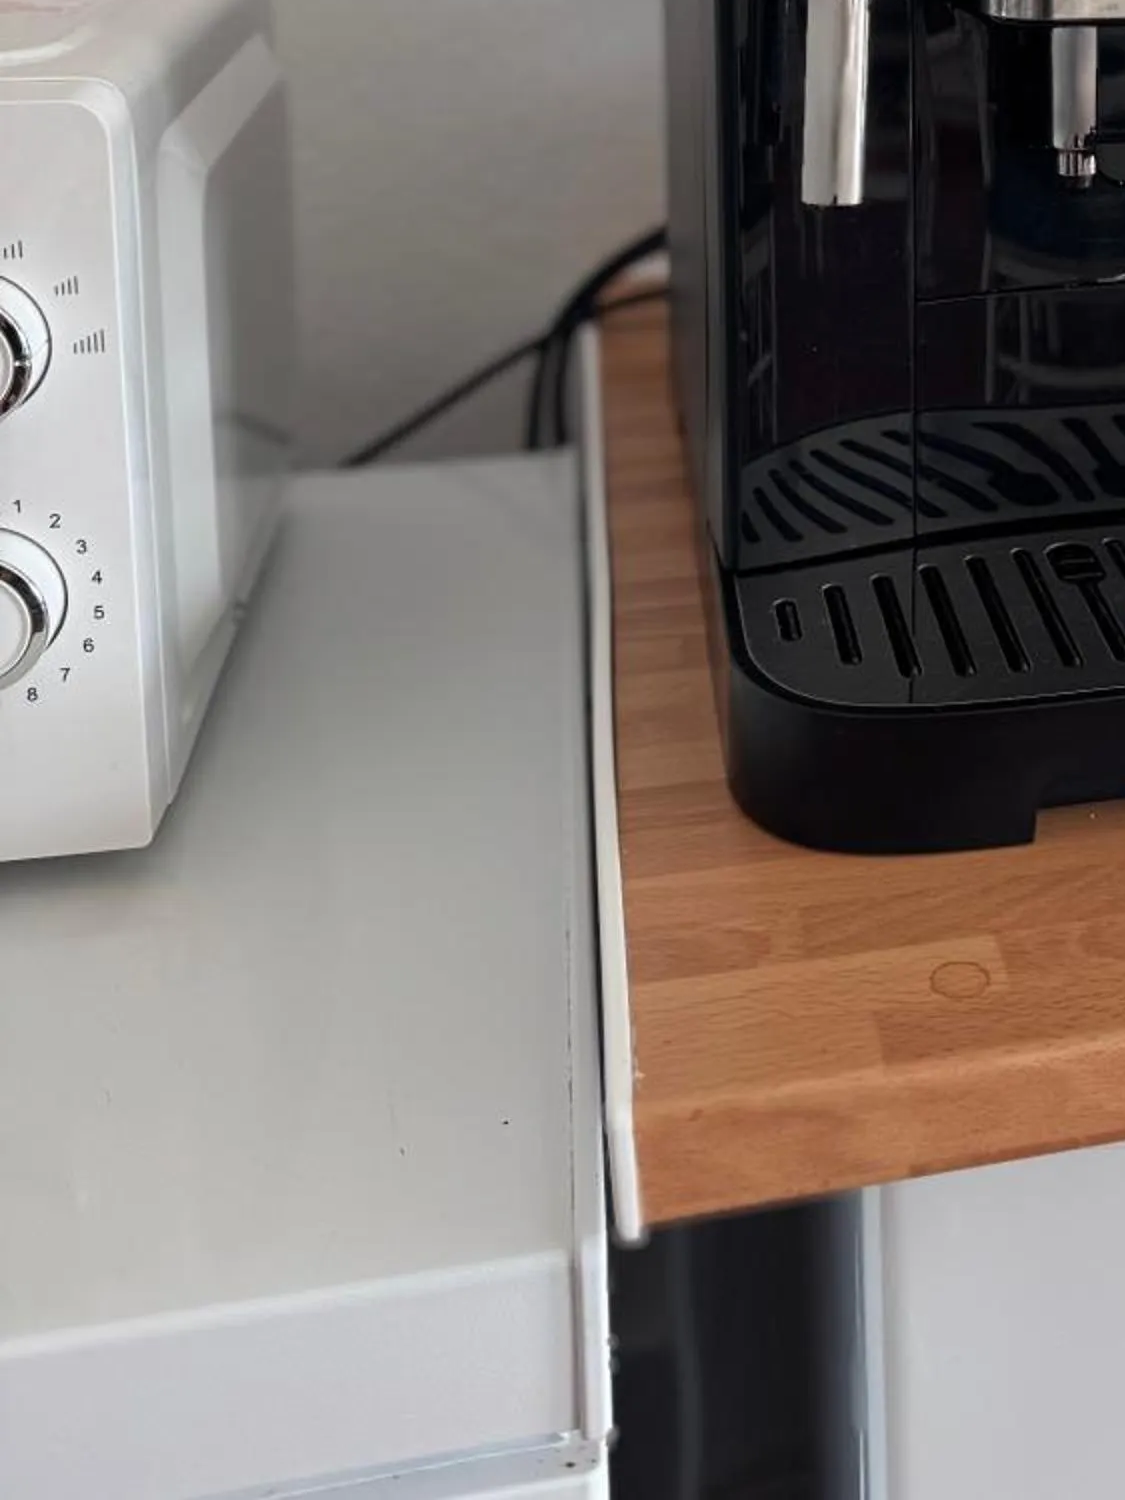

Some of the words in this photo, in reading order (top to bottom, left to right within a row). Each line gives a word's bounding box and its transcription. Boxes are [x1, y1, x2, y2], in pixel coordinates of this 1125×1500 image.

[13, 500, 22, 513] 1
[49, 513, 61, 529] 2
[75, 539, 88, 554] 3
[91, 570, 103, 585] 4
[93, 605, 105, 620] 5
[83, 638, 95, 653] 6
[60, 667, 71, 682] 7
[27, 687, 38, 702] 8
